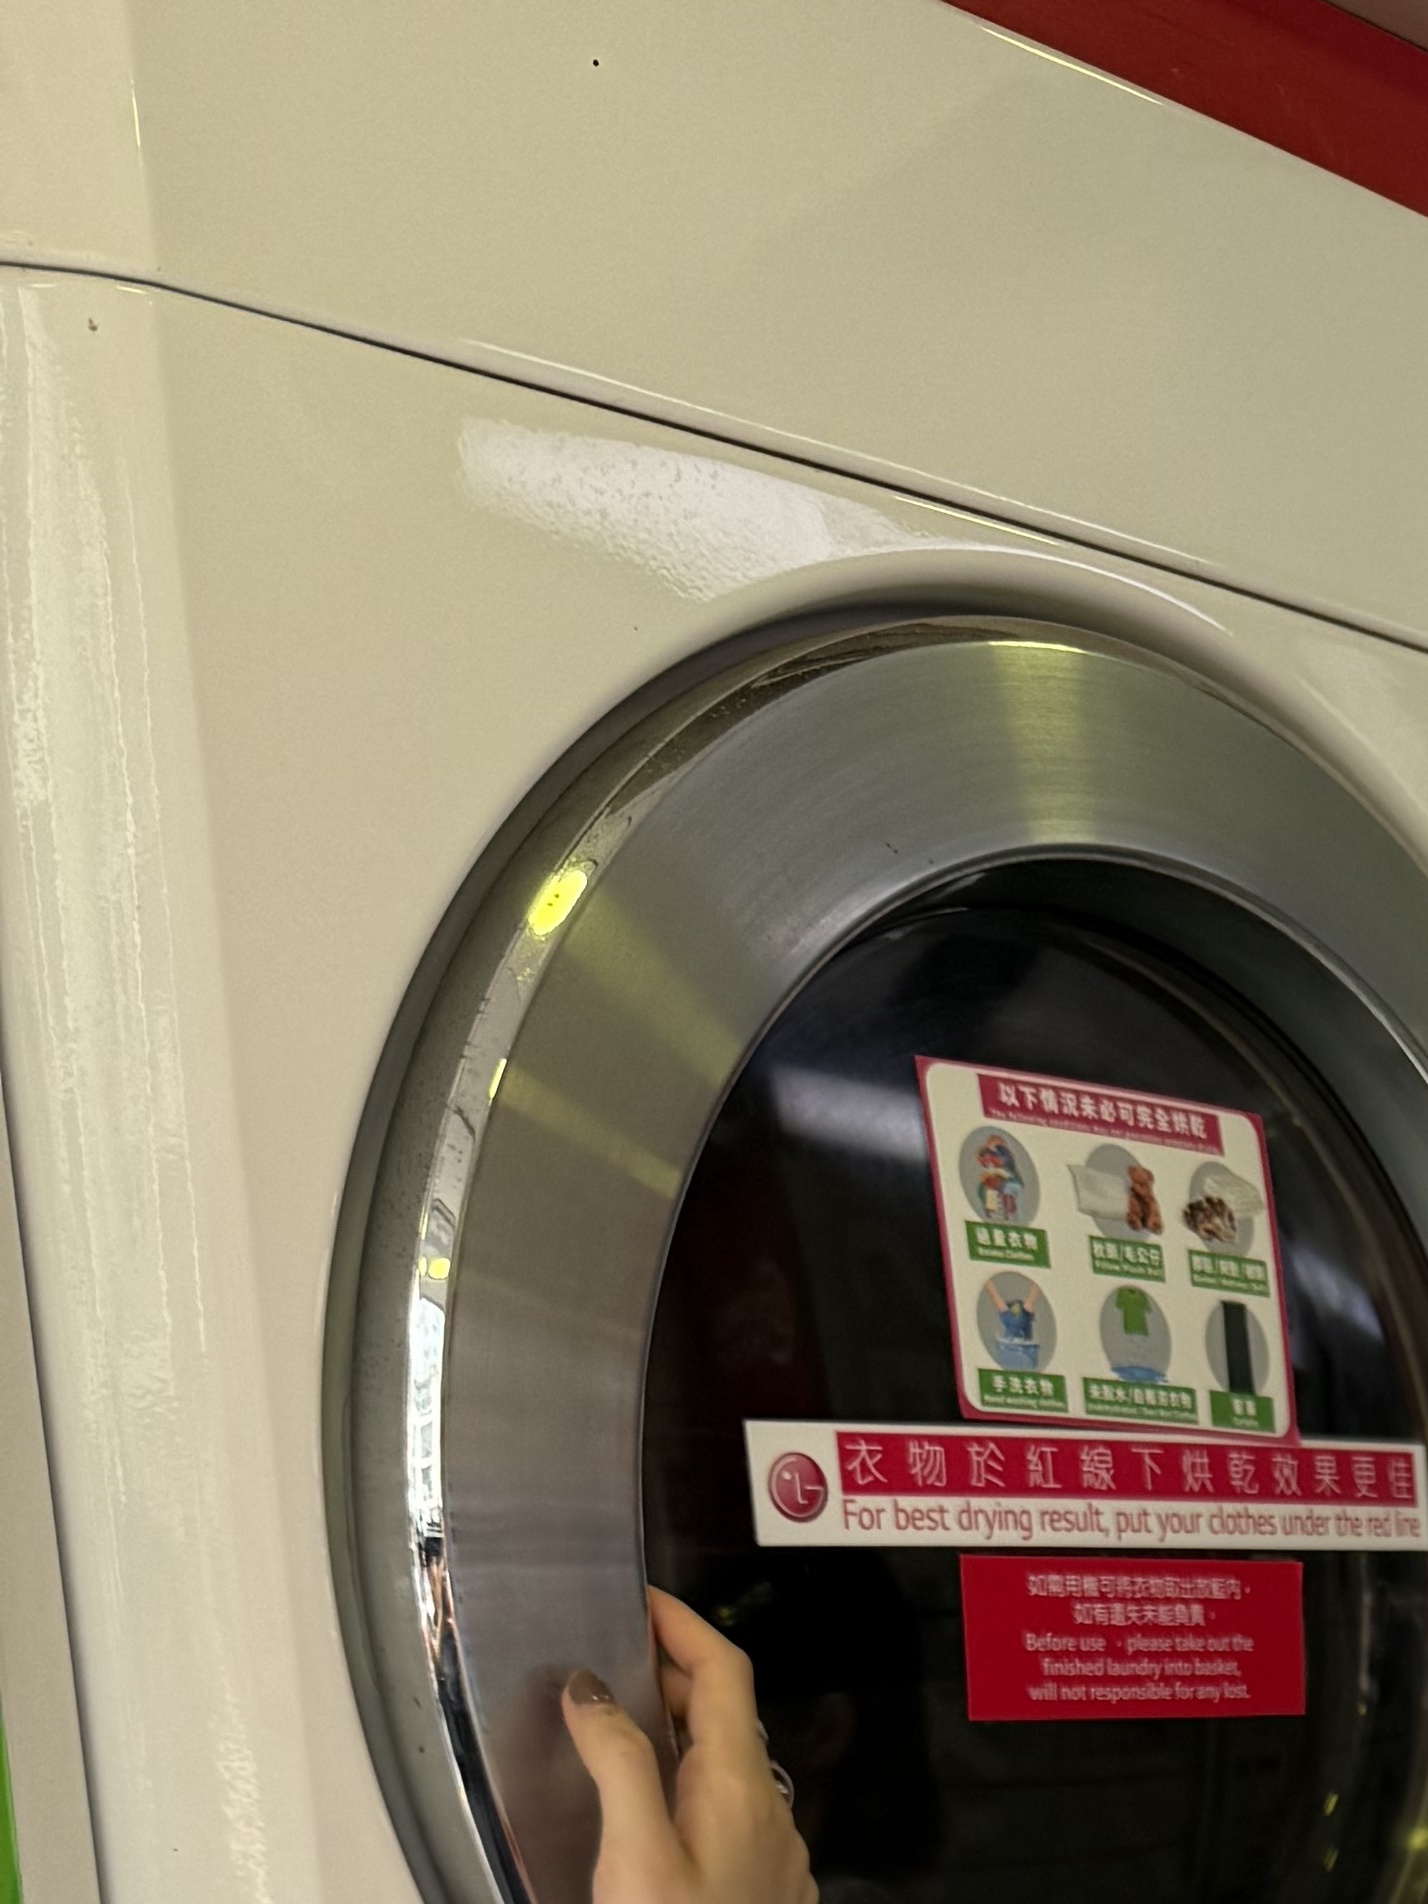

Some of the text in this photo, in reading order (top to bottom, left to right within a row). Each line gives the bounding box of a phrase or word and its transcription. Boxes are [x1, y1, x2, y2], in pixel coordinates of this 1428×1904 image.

[845, 1440, 1412, 1499] 衣物於紅線下烘乾效果更佳
[842, 1499, 885, 1530] For
[894, 1499, 950, 1531] best
[958, 1500, 1033, 1541] drying
[1040, 1502, 1110, 1537] result,
[1116, 1507, 1151, 1541] put
[1158, 1509, 1201, 1541] your
[1208, 1506, 1277, 1536] clothes
[1282, 1507, 1329, 1537] under
[1334, 1508, 1362, 1537] the
[1025, 1632, 1077, 1652] Before
